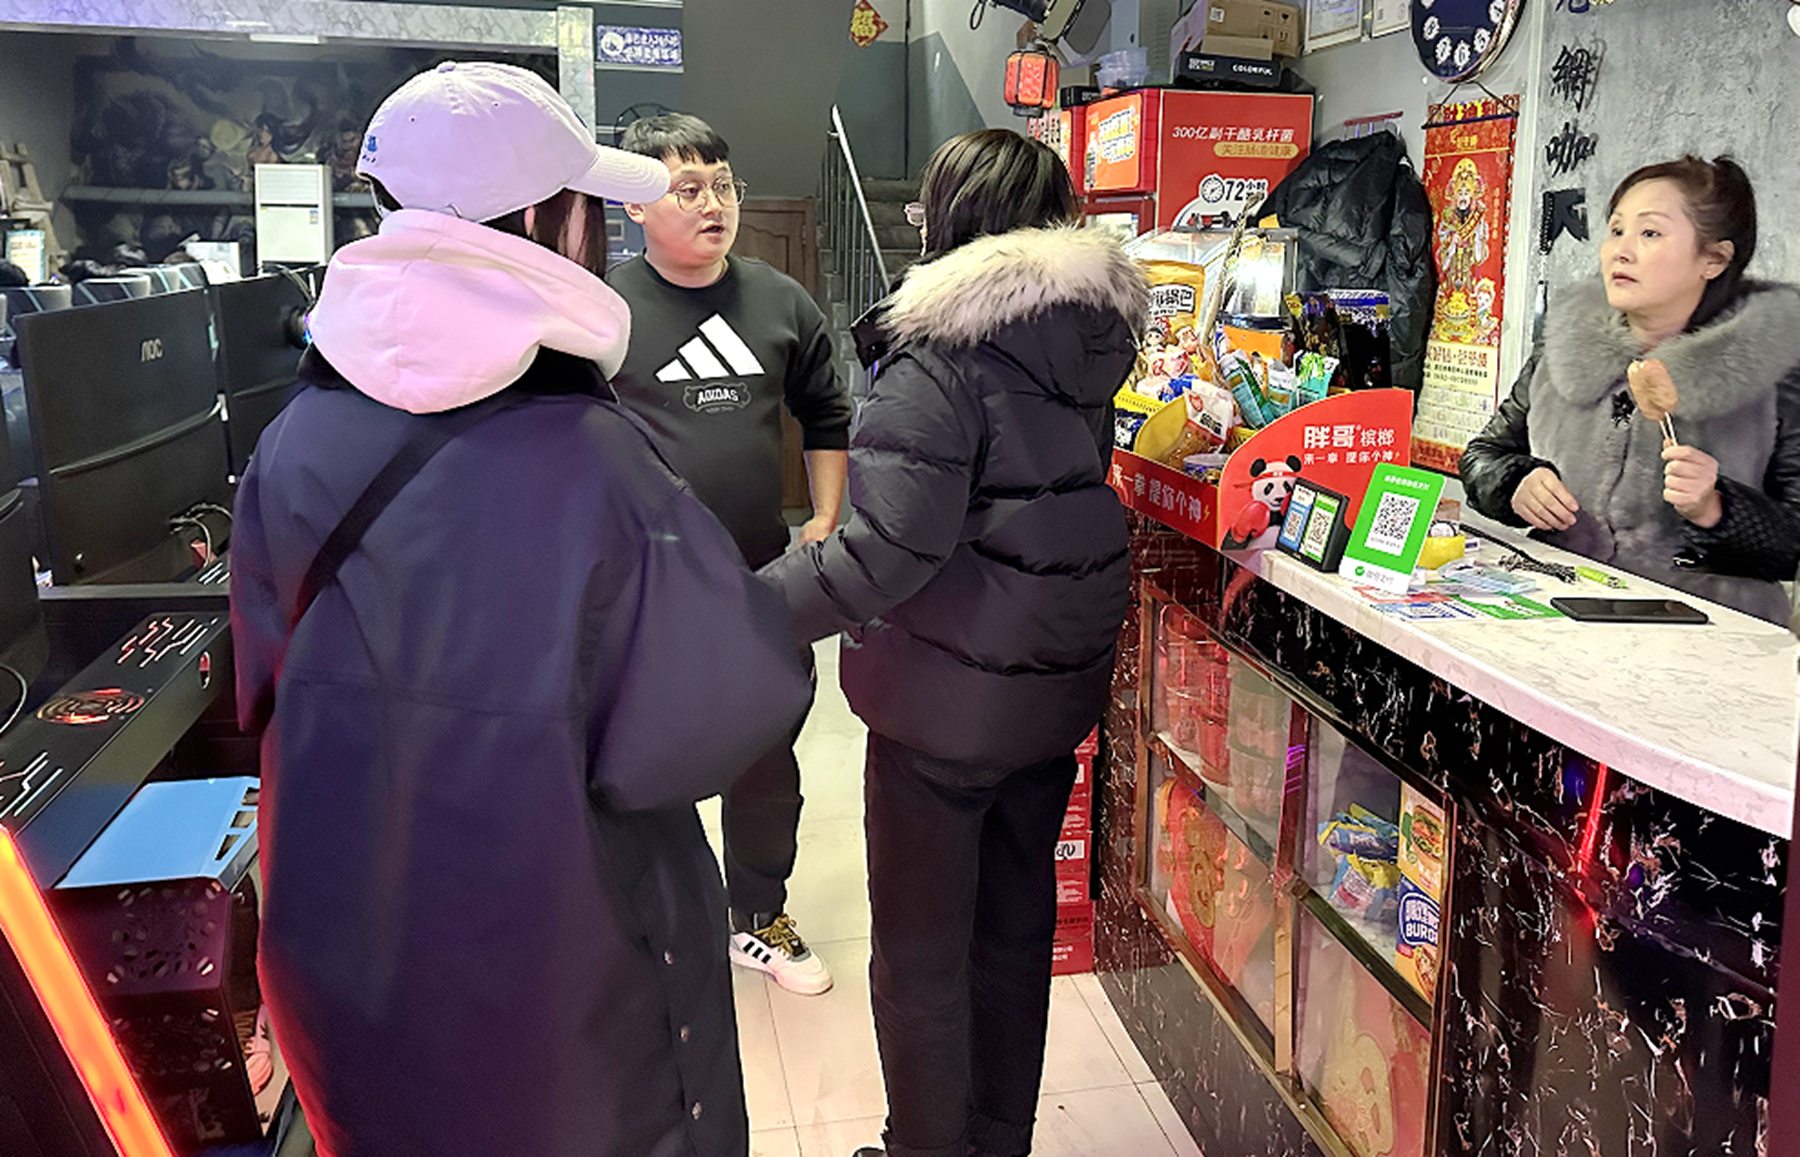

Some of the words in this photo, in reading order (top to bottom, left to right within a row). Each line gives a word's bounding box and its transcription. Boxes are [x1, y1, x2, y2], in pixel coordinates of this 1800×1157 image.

[1233, 64, 1273, 76] COLORFUL
[697, 387, 739, 405] ADIDAS
[1304, 424, 1355, 448] 胖哥
[1361, 428, 1395, 446] 槟榔
